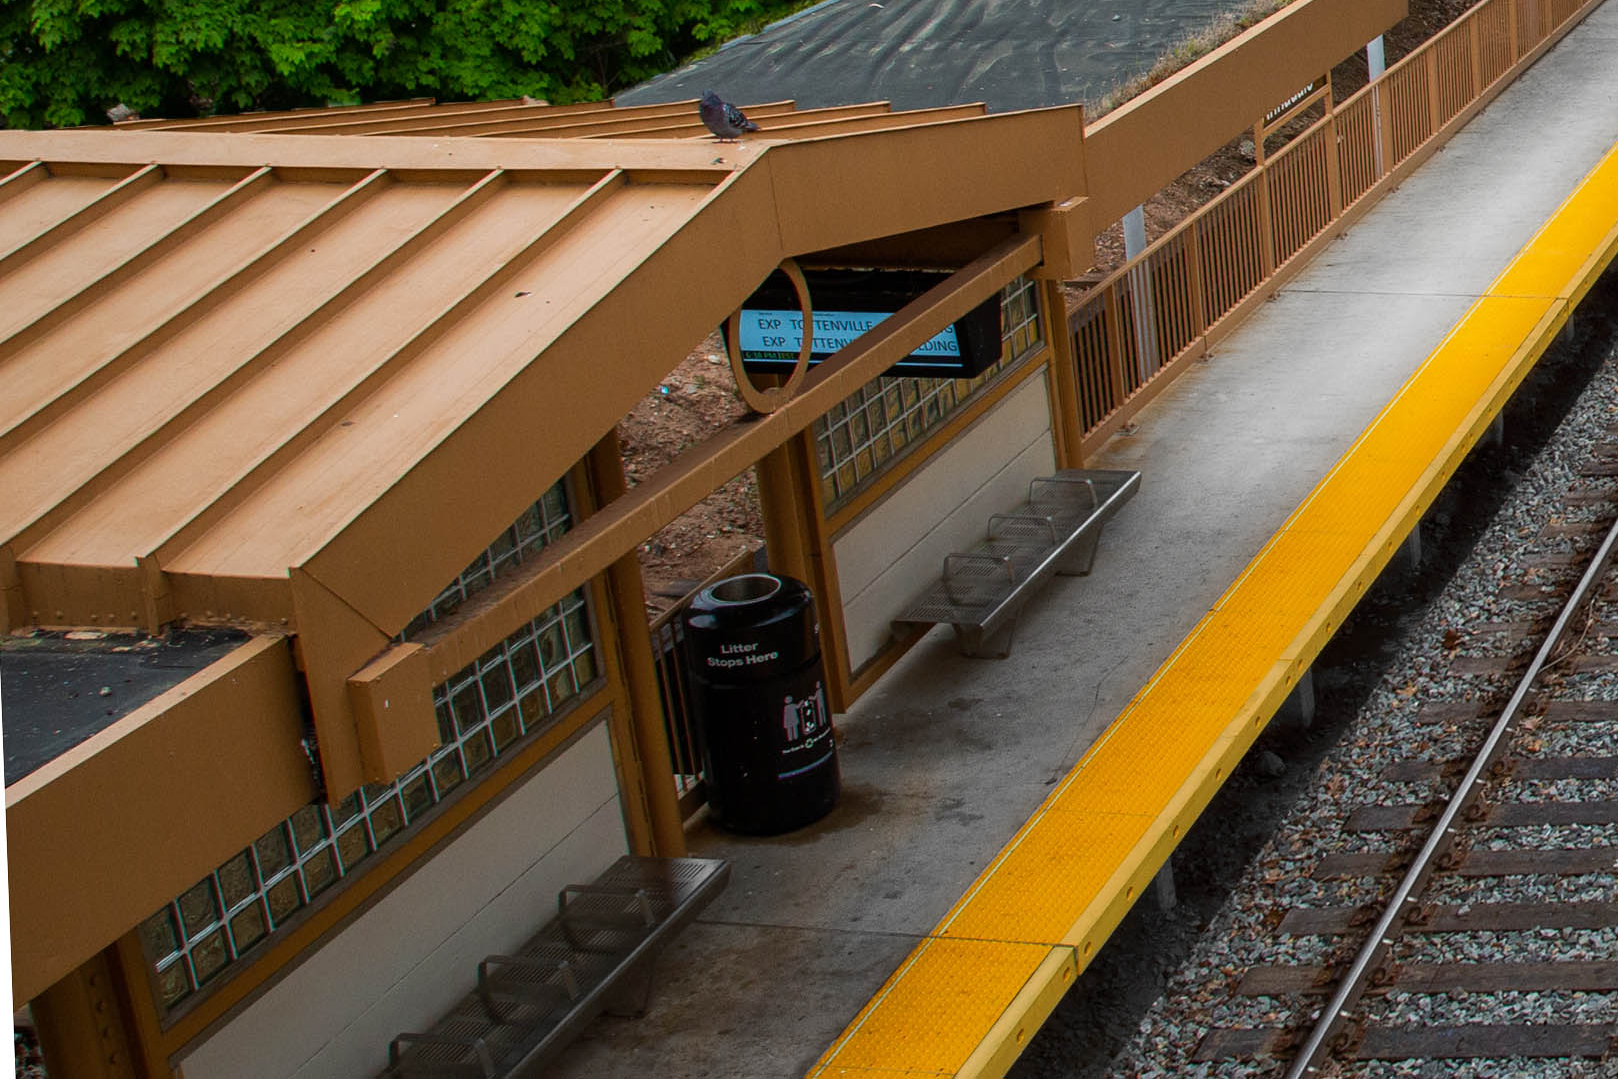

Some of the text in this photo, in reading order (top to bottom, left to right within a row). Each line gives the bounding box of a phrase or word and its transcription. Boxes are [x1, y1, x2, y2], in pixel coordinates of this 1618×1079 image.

[758, 319, 781, 330] EXP
[762, 337, 786, 347] EXP
[721, 643, 758, 654] Litter
[707, 652, 779, 668] Stops Here
